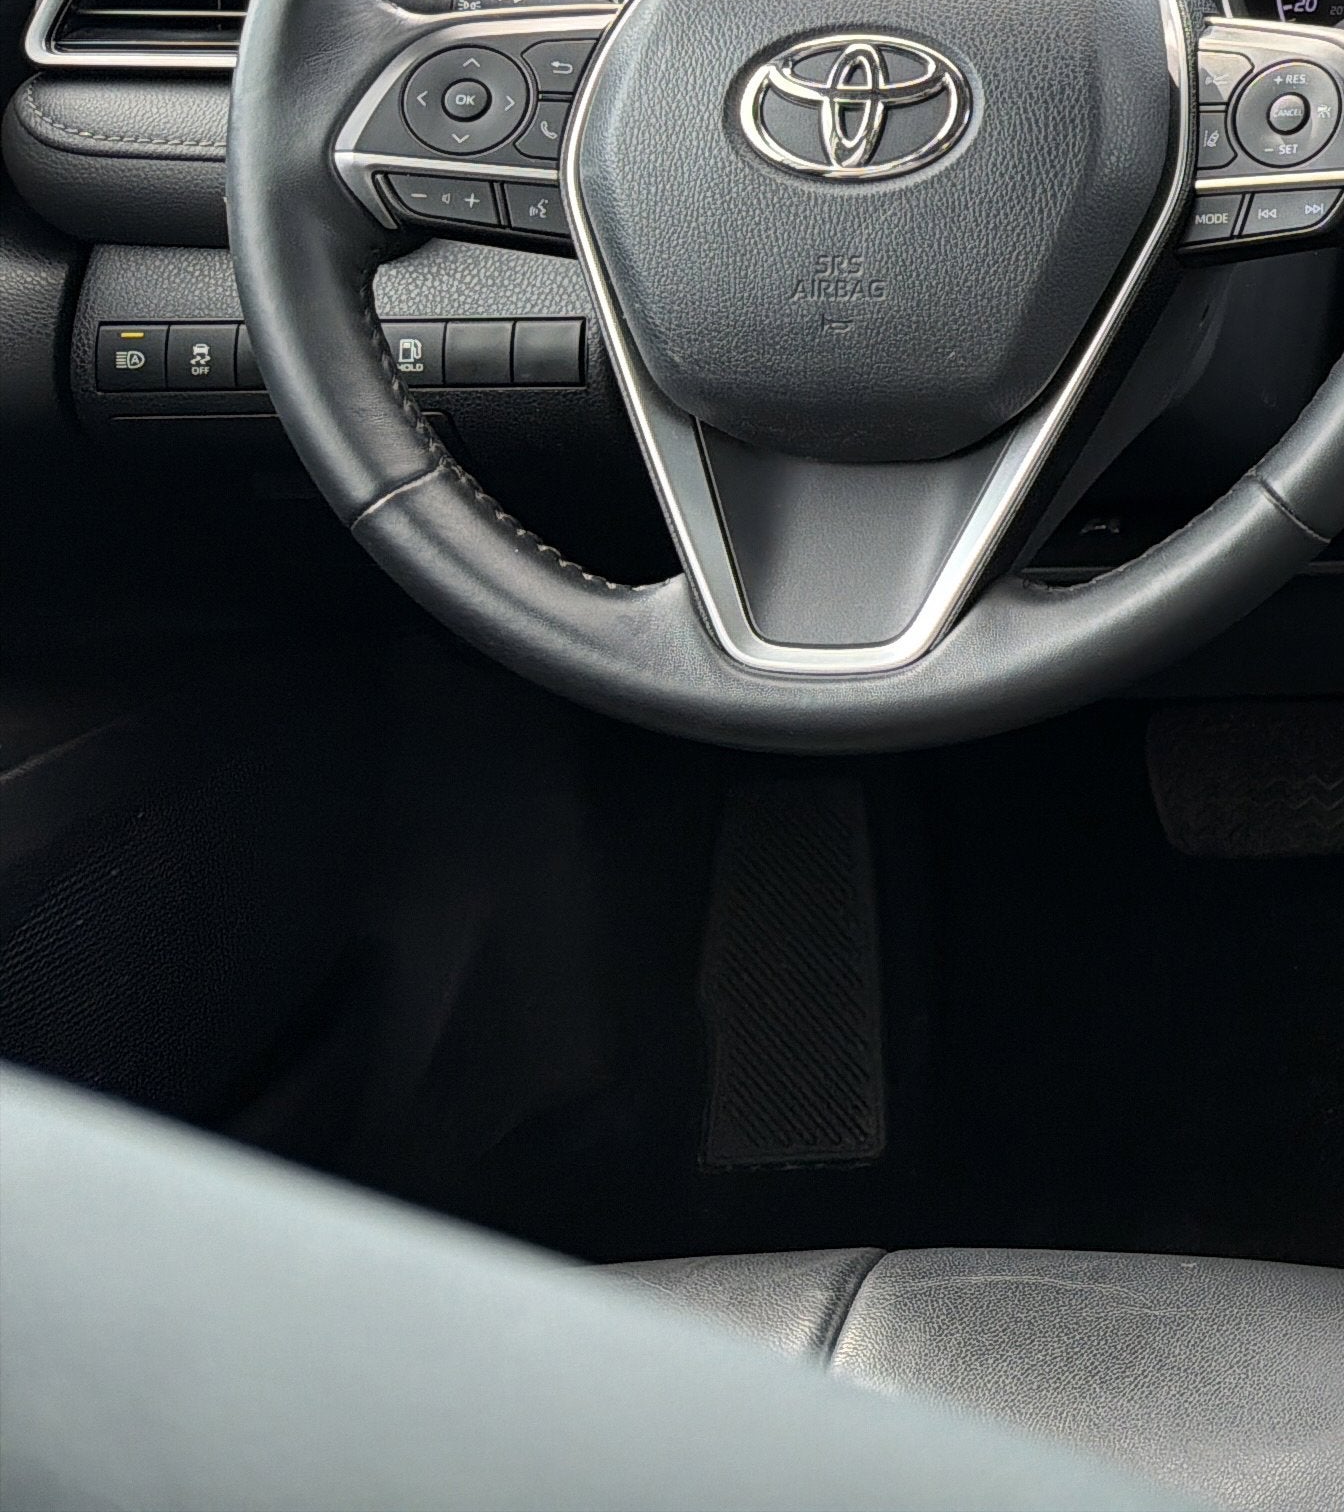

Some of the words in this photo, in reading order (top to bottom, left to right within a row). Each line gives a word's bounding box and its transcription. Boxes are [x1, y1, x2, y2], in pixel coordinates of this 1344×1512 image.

[1329, 6, 1344, 16] 20
[455, 94, 476, 106] OK
[1272, 107, 1303, 118] CANCEL
[1194, 212, 1229, 225] MODE
[814, 254, 863, 275] SRS
[788, 278, 887, 300] AIRBAG
[191, 366, 211, 376] OFF
